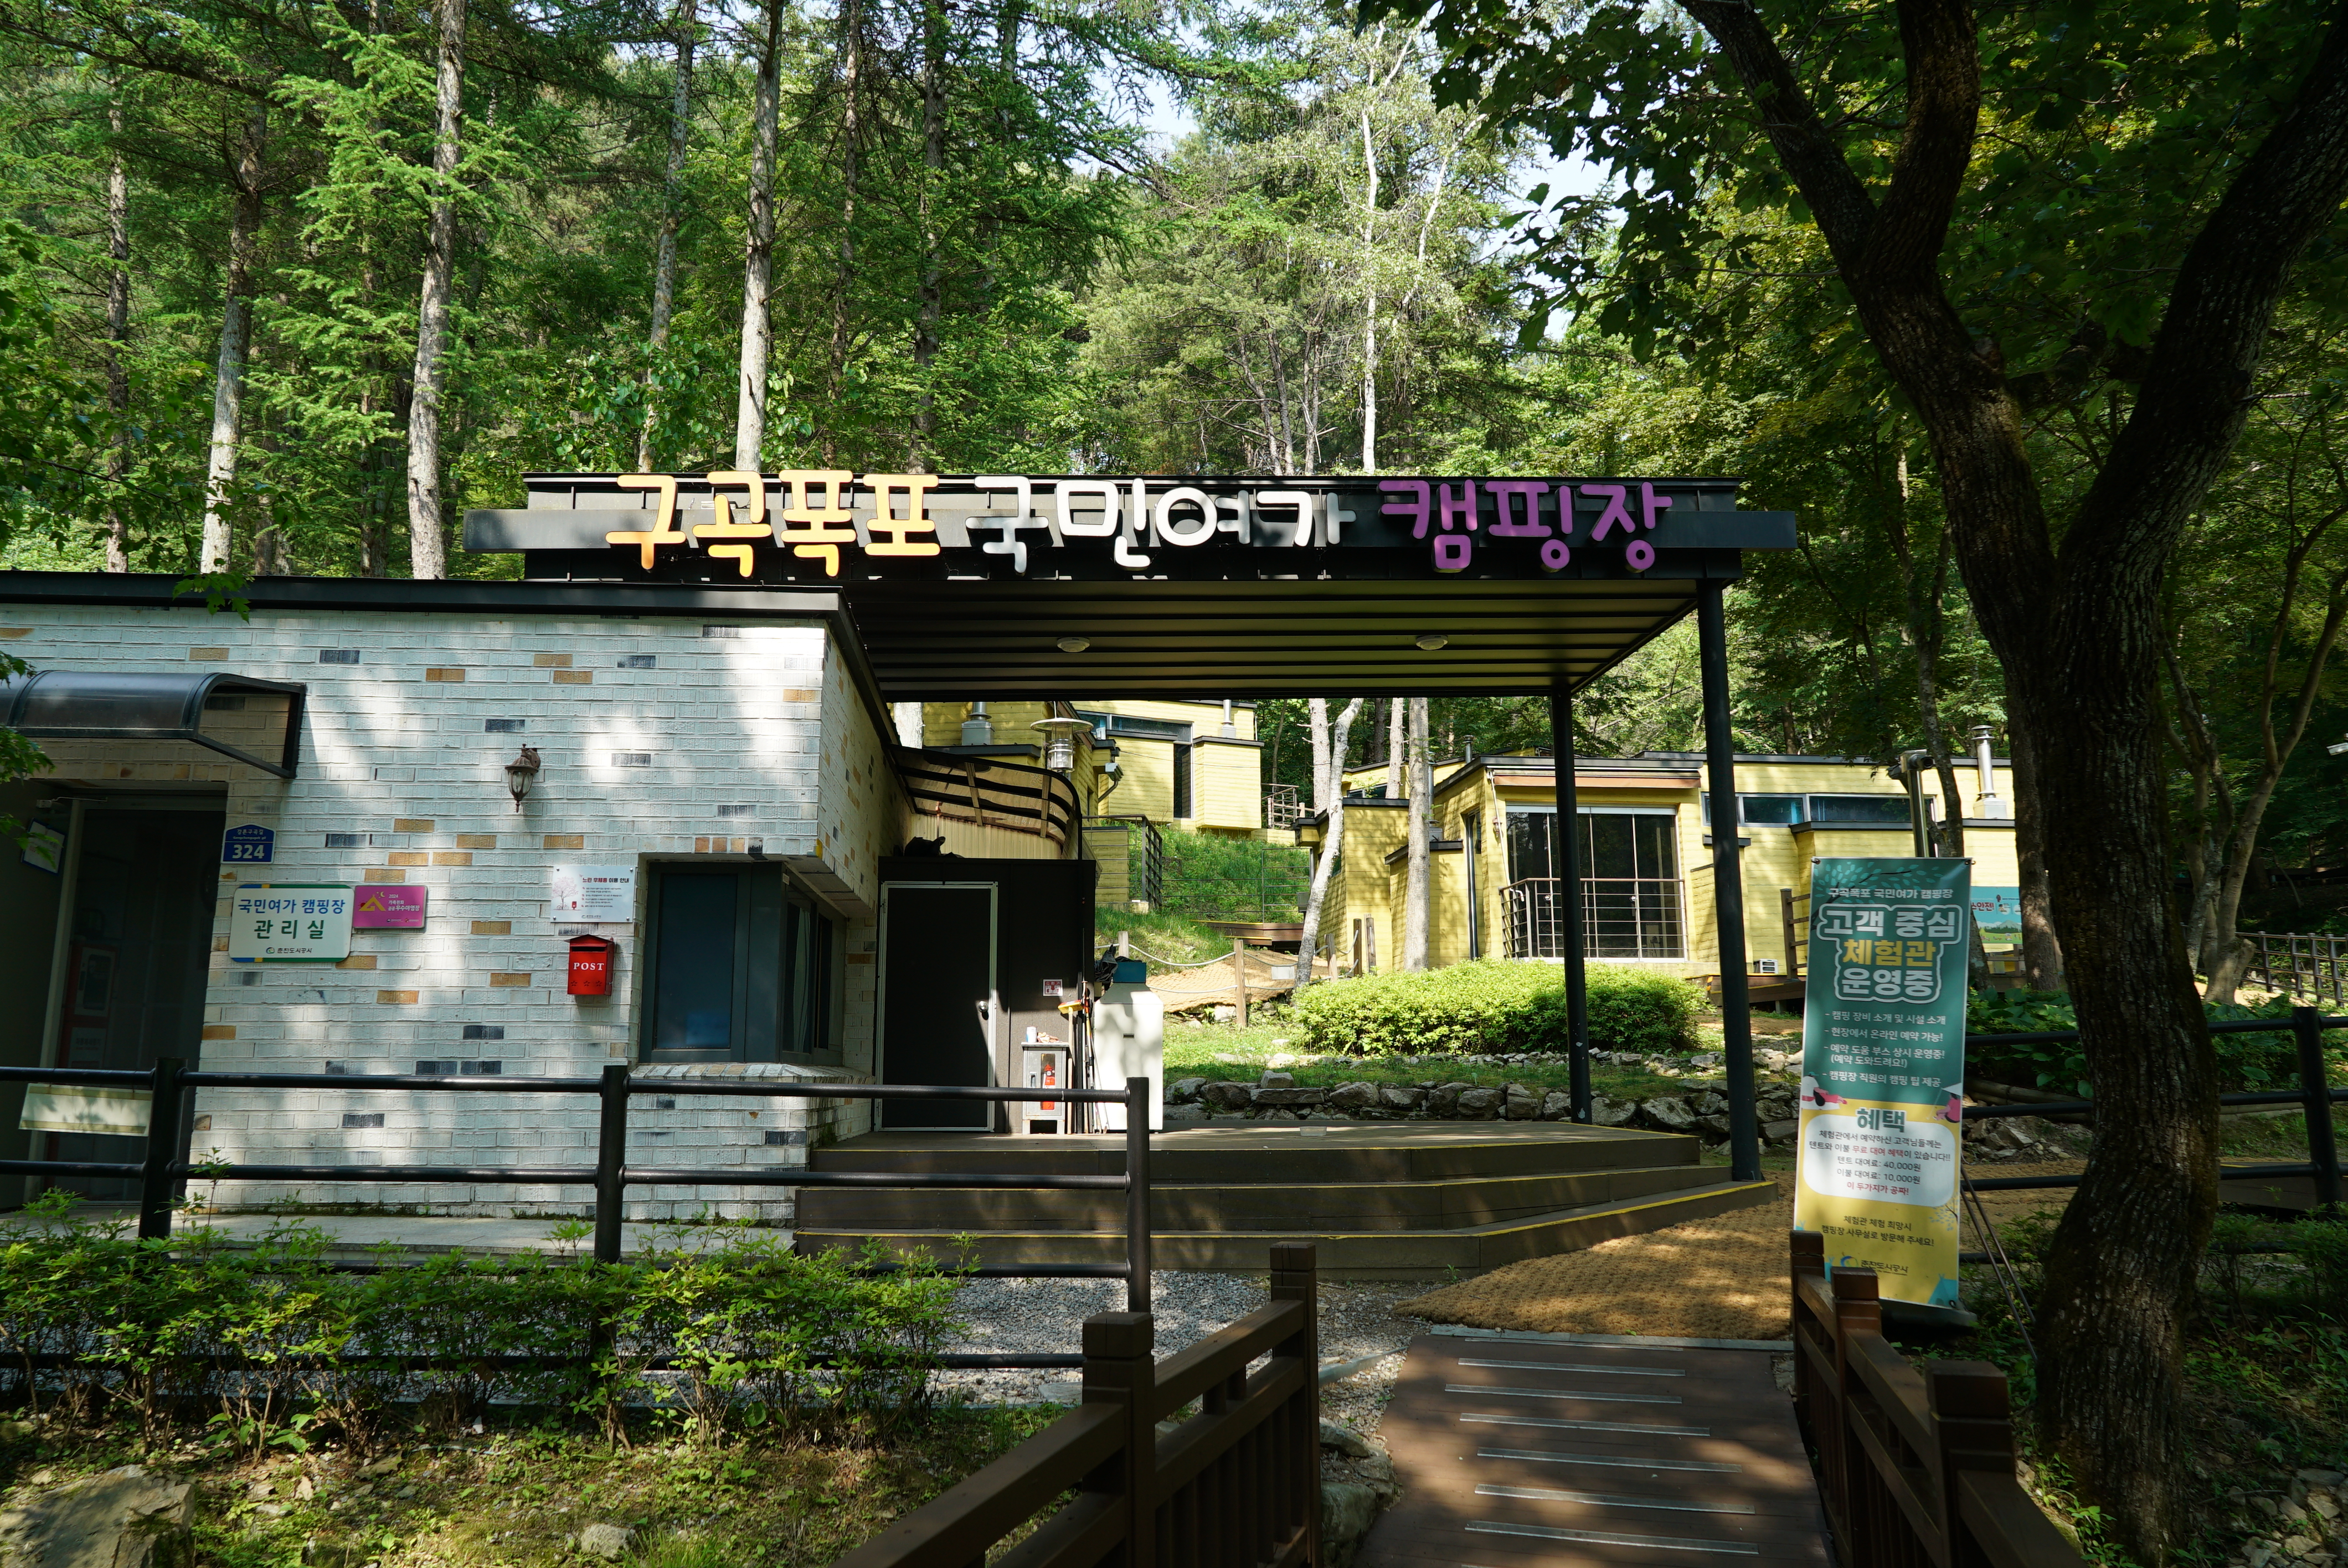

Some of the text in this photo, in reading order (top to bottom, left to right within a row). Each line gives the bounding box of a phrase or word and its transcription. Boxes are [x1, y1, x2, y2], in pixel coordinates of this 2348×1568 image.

[605, 470, 1673, 577] 구곡폭포 국민여가 캠핑장
[232, 844, 265, 859] 324
[1828, 888, 1954, 899] 구곡폭포 국민여가 캠핑장
[238, 899, 346, 914] 국민여가 캠핑장
[1824, 910, 1955, 937] 고객 중심
[1842, 939, 1936, 967] 체험관
[573, 962, 604, 971] POST
[1842, 968, 1934, 996] 운영중
[1831, 1011, 1947, 1025] 캠핑 장비 소개 및 시설 소개
[1831, 1027, 1944, 1043] 현장에서 온라인 예약 가능!
[1830, 1044, 1945, 1060] 예약 도움 부스 상시 운영중!
[1830, 1054, 1908, 1069] (예약 도와드려요!)
[1829, 1071, 1942, 1087] 캠핑장 직원의 캠핑 팁 제공
[1857, 1108, 1905, 1133] 혜택
[1819, 1129, 1943, 1149] 체험관에서 예약하신 고객님들께는
[1809, 1141, 1951, 1162] 텐트와 이불 무료 대여 혜택이 있습니다!!
[1837, 1156, 1921, 1172] 텐트 대여료: 40,000원
[1837, 1168, 1920, 1184] 이불 대여료: 10,000원
[1847, 1182, 1909, 1195] 이 두가지가 공짜!
[1844, 1215, 1912, 1231] 체험관 체험 희망시
[1821, 1225, 1935, 1246] 캠핑장 사무실로 방문해 주세요!
[1861, 1260, 1909, 1273] 춘천도시공사
